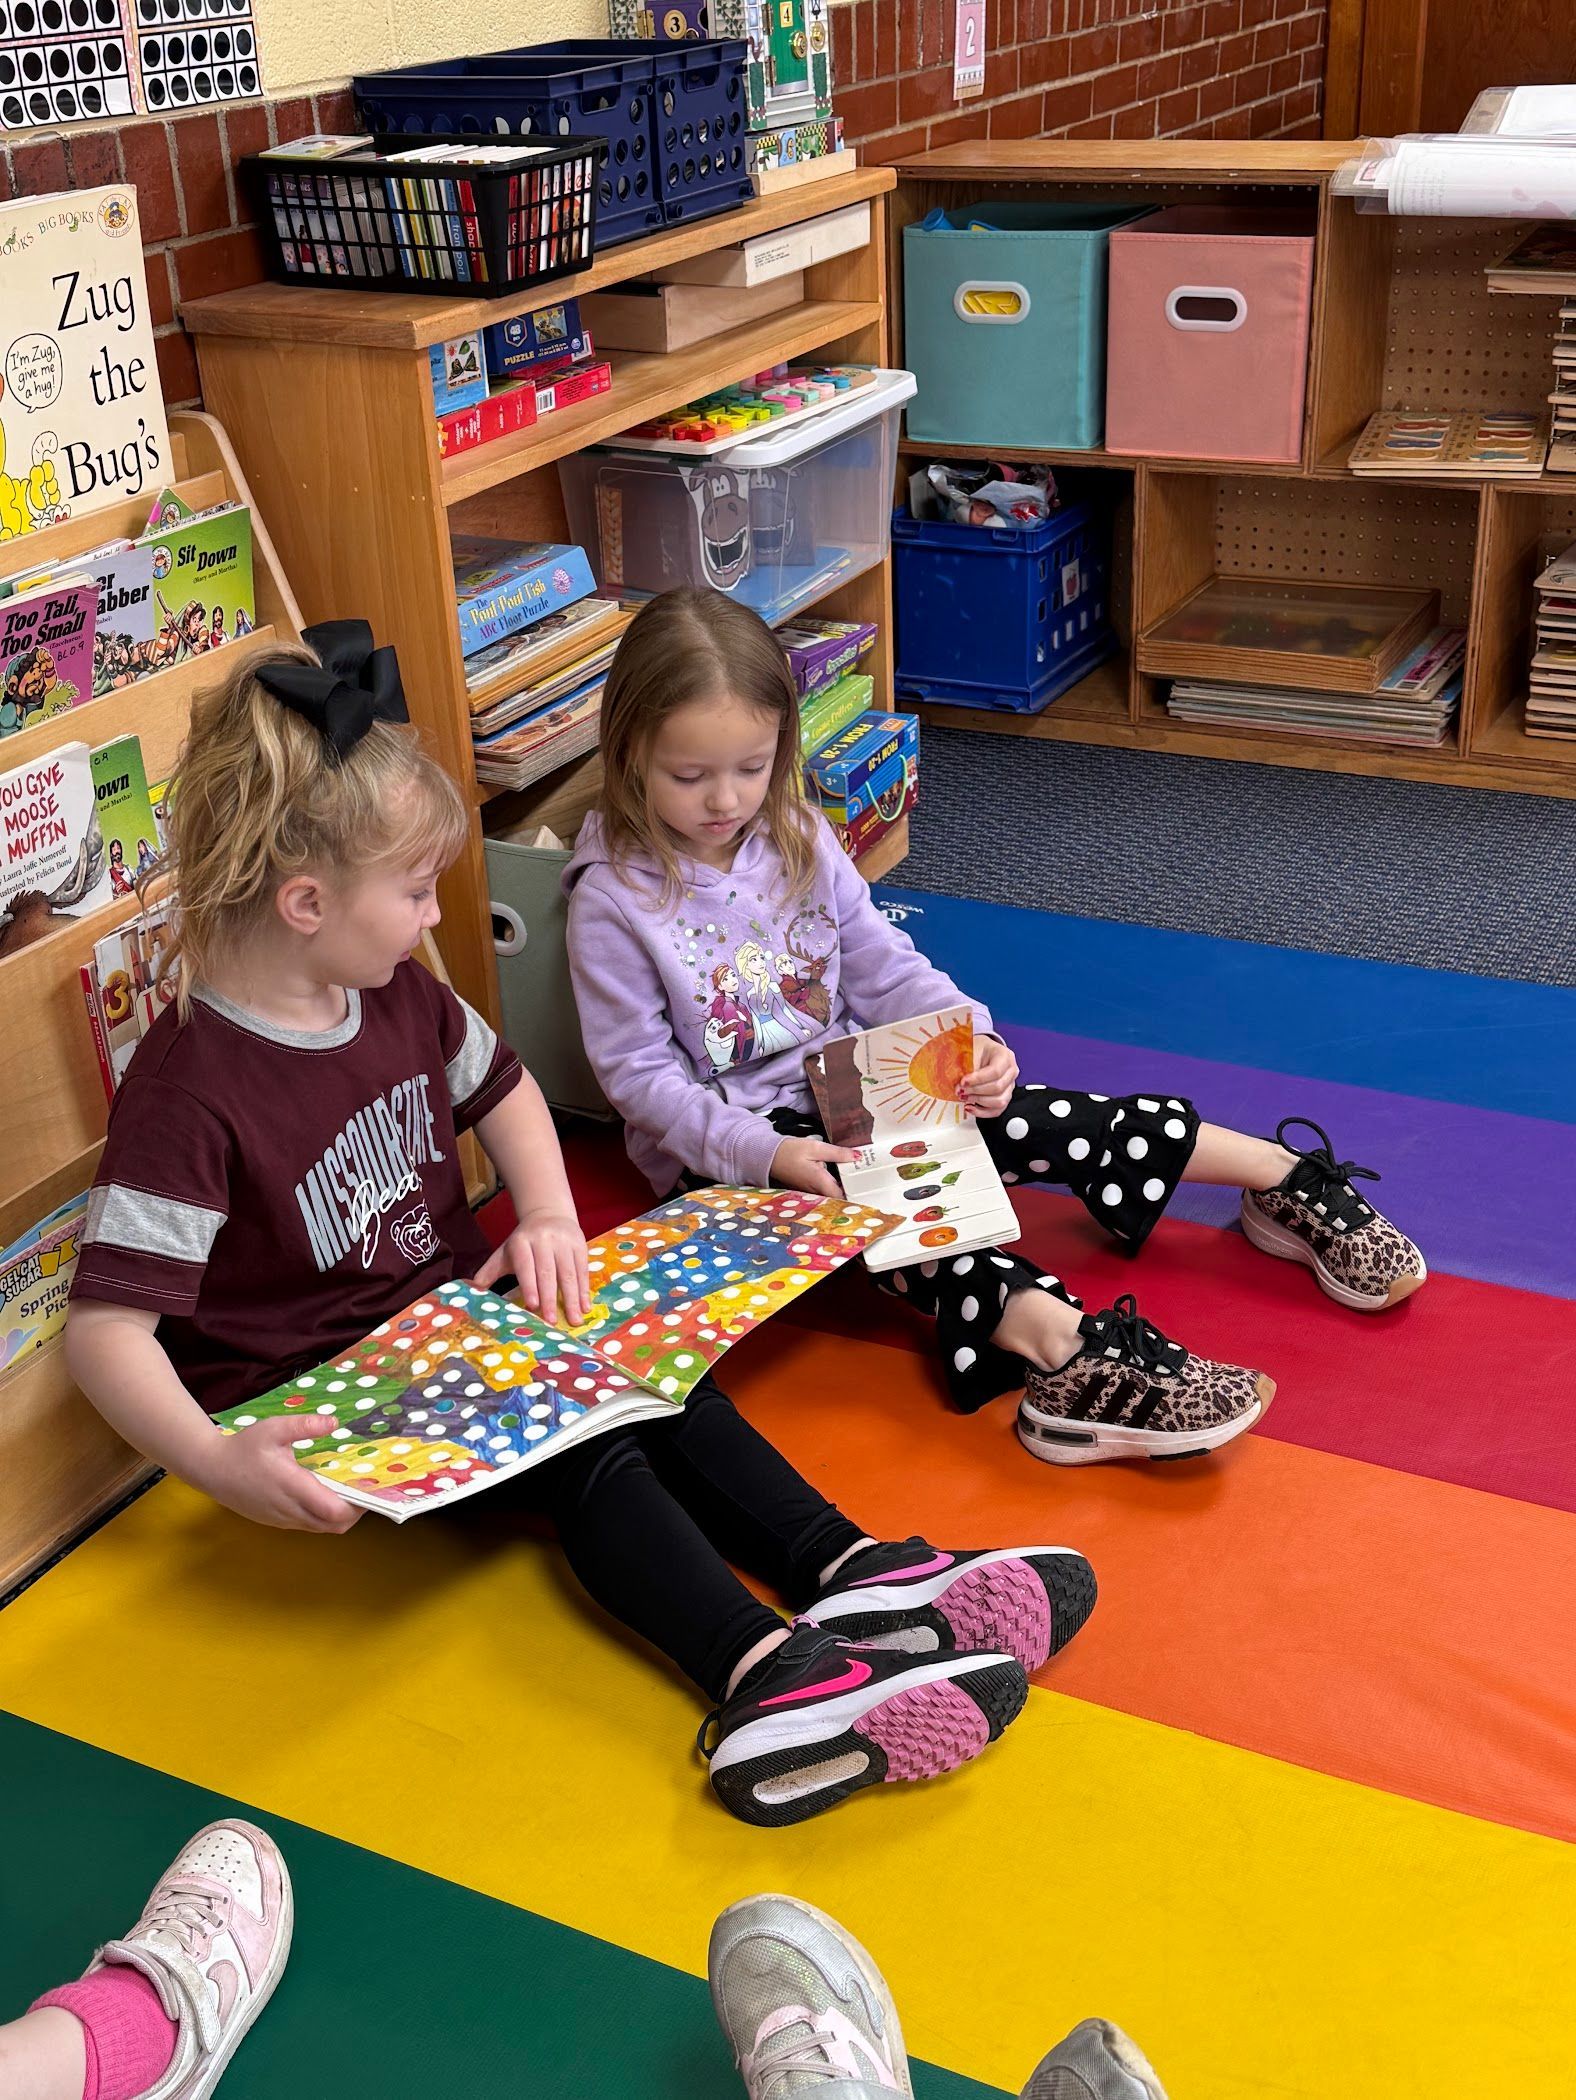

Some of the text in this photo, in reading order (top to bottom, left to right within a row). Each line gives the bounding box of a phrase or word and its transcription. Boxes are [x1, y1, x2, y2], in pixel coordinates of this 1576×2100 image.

[670, 16, 681, 33] 3
[783, 7, 791, 23] 4
[966, 16, 976, 58] 2
[38, 216, 57, 235] BIG
[58, 211, 94, 226] BOOKS
[452, 223, 466, 276] tranport
[52, 271, 136, 332] Zug
[10, 345, 56, 371] I'm Zug,
[503, 351, 535, 366] PUZZLE
[18, 364, 55, 391] give me
[26, 374, 56, 399] a hug!
[89, 346, 147, 406] the
[61, 418, 160, 498] Bug's
[177, 544, 197, 567] Sit
[197, 544, 237, 572] Down
[96, 572, 115, 593] er
[208, 571, 218, 580] and
[4, 593, 80, 636] Too Tall,
[96, 585, 150, 616] abber
[476, 598, 488, 610] The
[479, 597, 550, 640] ABC Floor Puzzle
[0, 610, 87, 660] Too Small
[839, 723, 875, 744] FROM
[881, 738, 899, 760] FROM
[820, 743, 849, 759] 1-20
[26, 762, 64, 796] GIVE
[94, 773, 130, 801] own
[826, 777, 838, 786] 3+
[4, 793, 59, 837] MOOSE
[8, 818, 67, 864] MUFFIN
[0, 855, 73, 898] ustrated by Felicia Bond
[3, 869, 23, 883] Laura
[105, 969, 130, 1019] 3
[295, 1073, 446, 1272] MISSOUR STATE
[352, 1171, 422, 1269] Bea
[0, 1252, 41, 1292] GEL CAT
[5, 1266, 43, 1302] SUGAR
[20, 1278, 70, 1318] Spring
[45, 1297, 70, 1320] Pic
